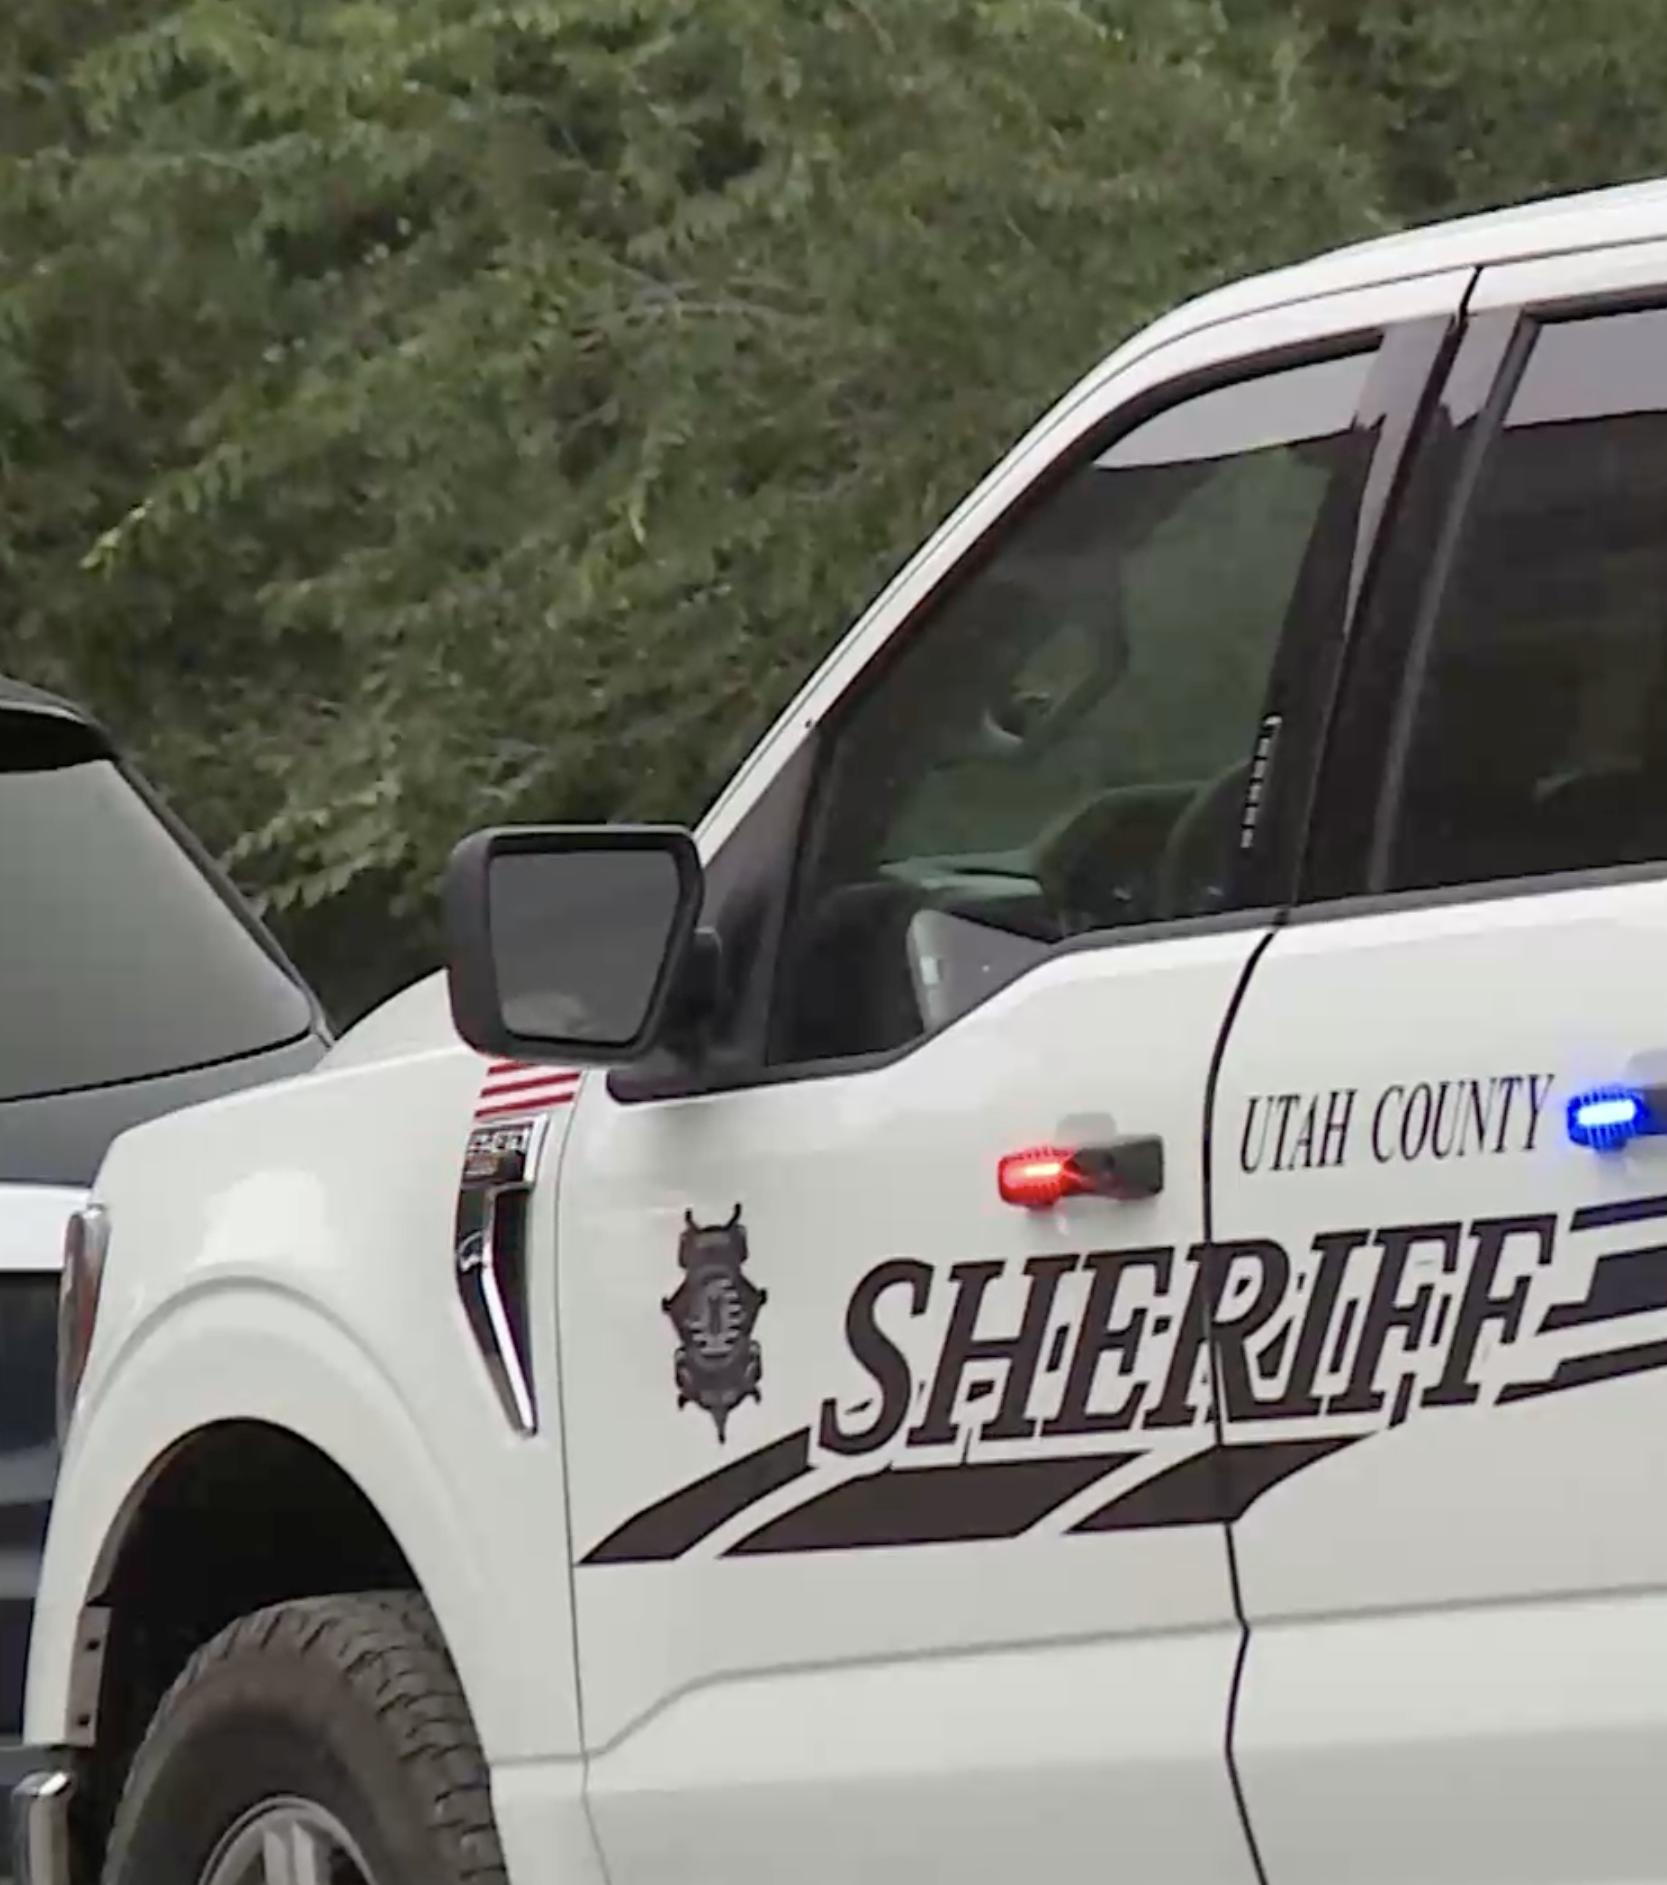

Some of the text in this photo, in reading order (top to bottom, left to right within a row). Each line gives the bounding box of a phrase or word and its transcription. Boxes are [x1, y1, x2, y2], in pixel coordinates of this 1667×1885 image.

[1240, 1073, 1556, 1174] UTAH COUNTY
[817, 1213, 1559, 1457] SHERIFF
